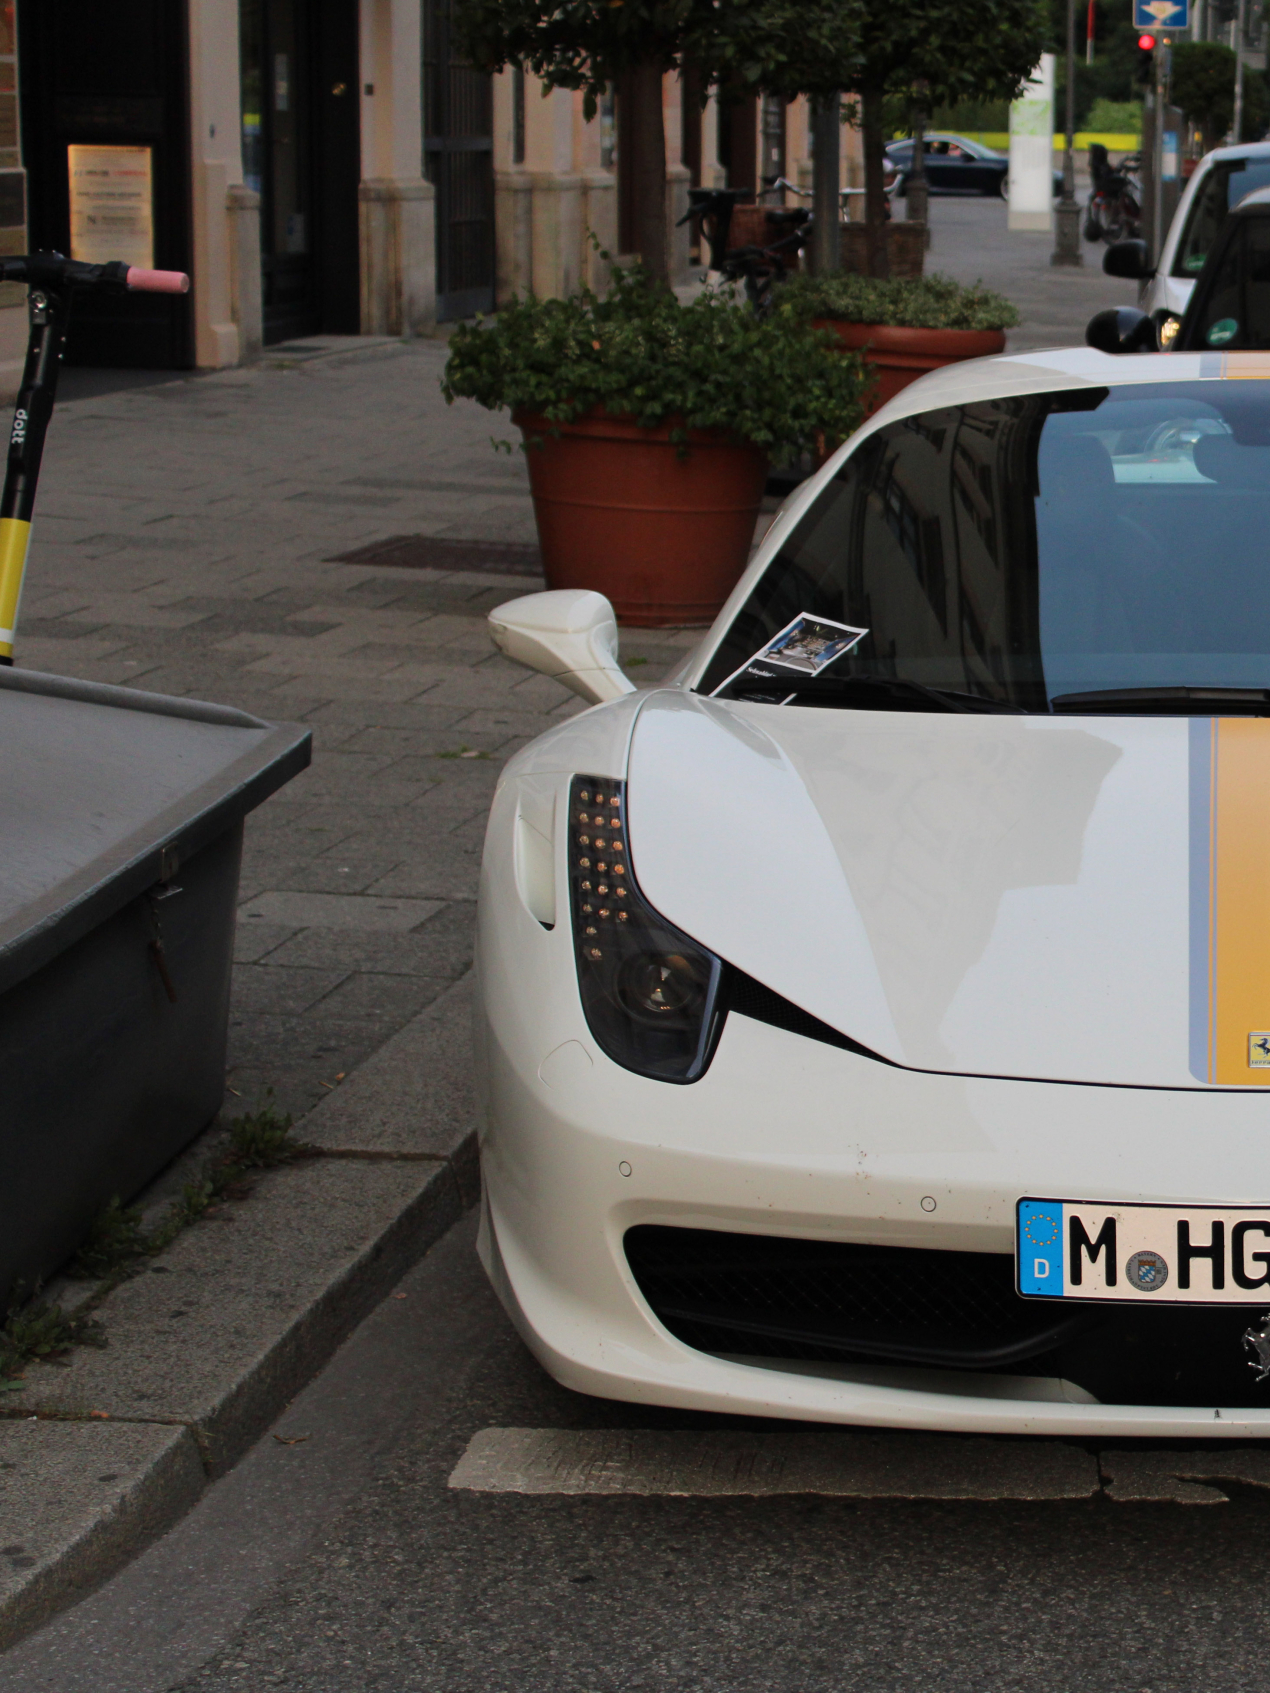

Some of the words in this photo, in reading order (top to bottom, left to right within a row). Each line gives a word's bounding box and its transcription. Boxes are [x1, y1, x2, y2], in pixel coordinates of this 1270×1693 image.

[11, 408, 28, 444] dott
[1034, 1258, 1050, 1278] D
[1069, 1215, 1117, 1287] M
